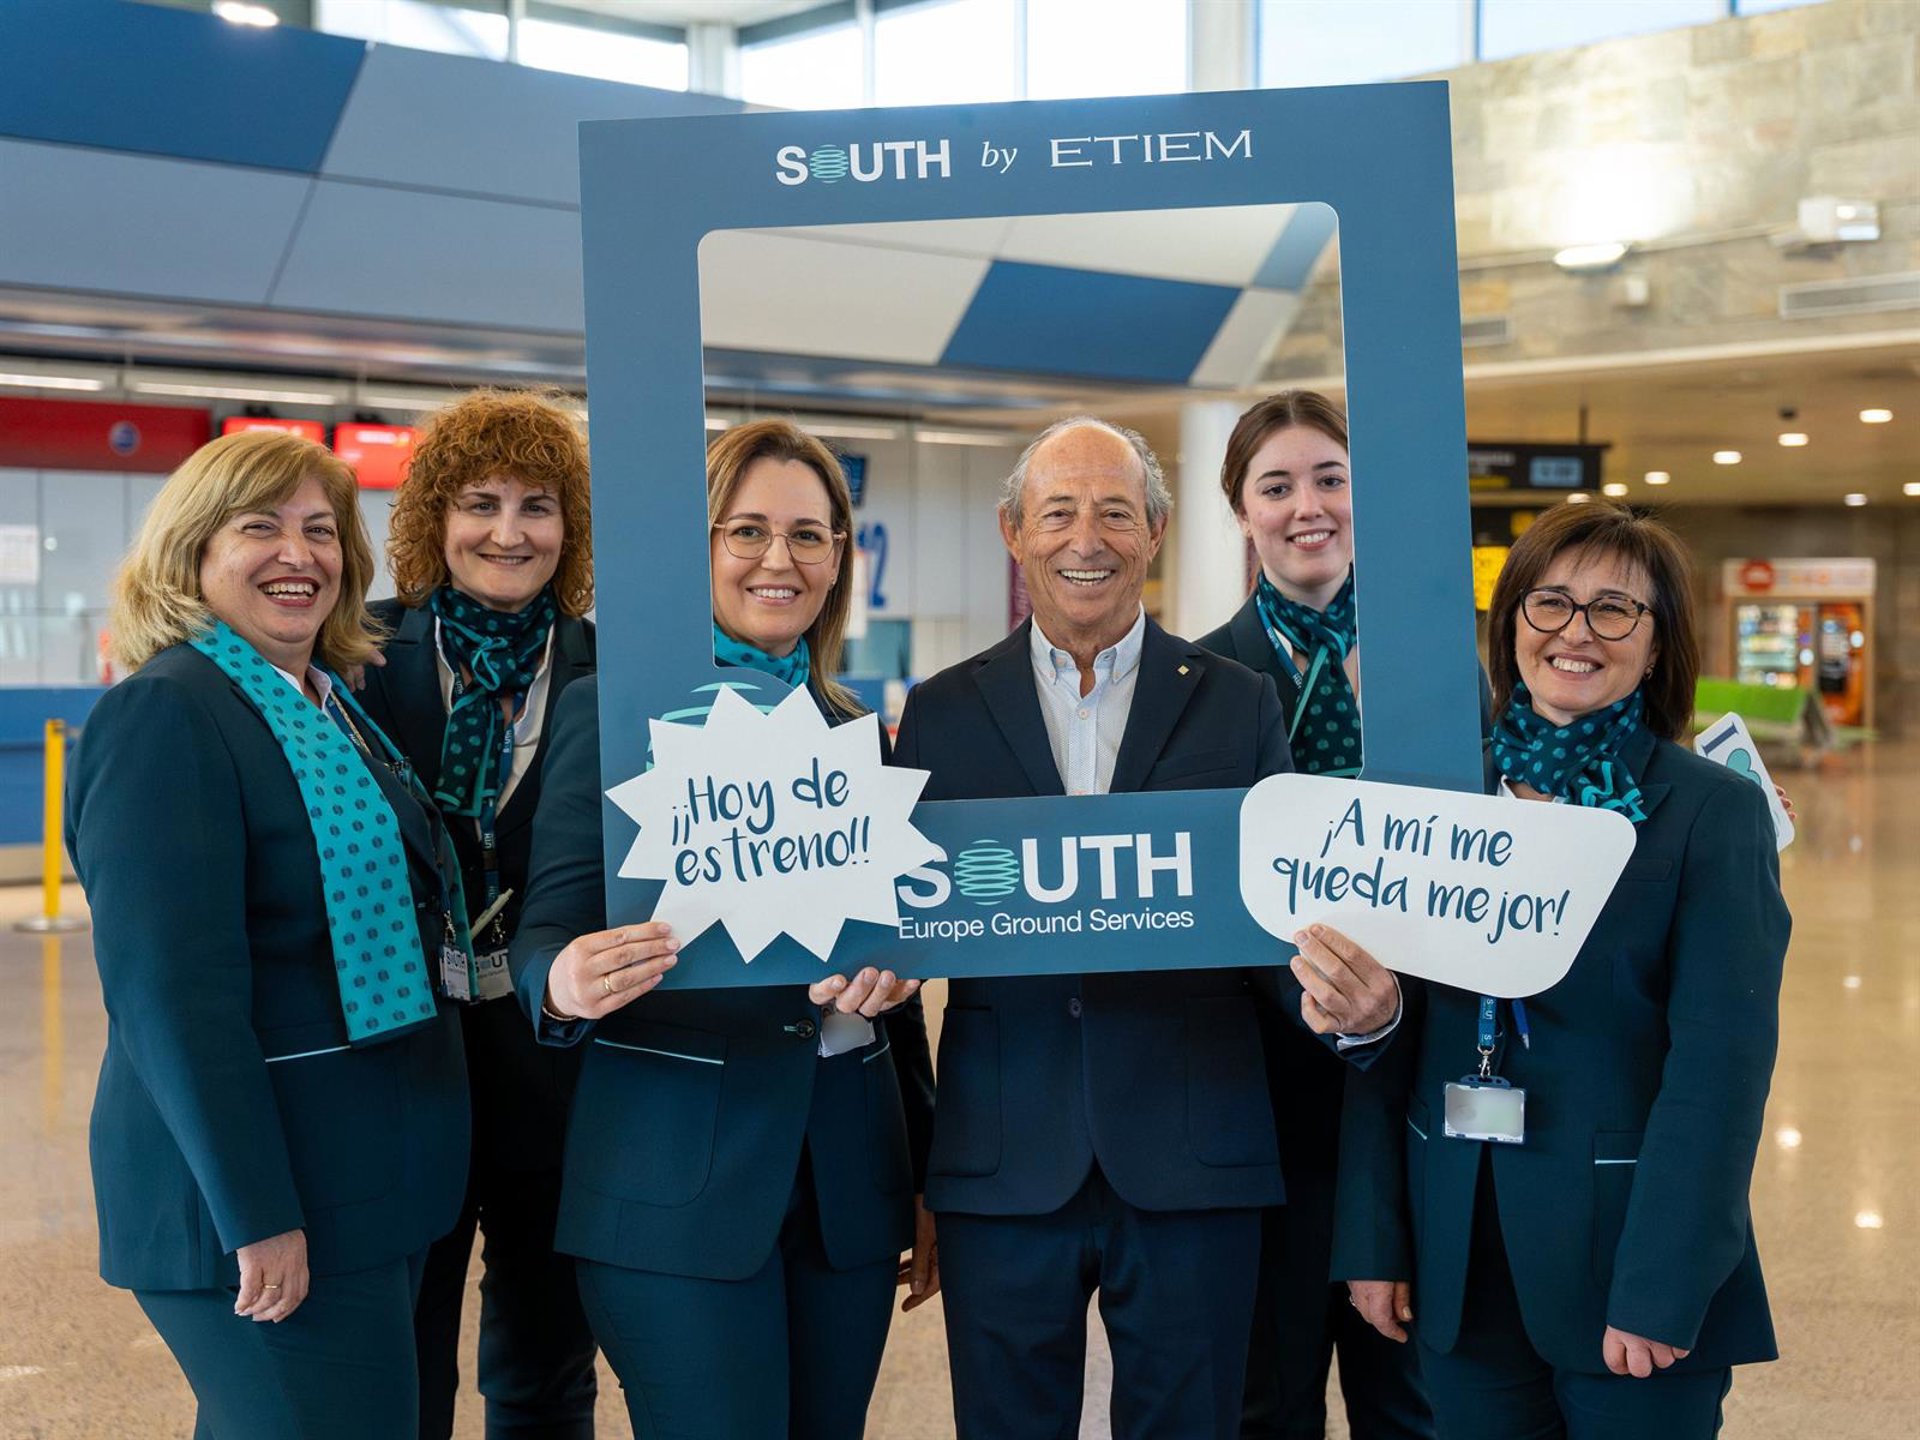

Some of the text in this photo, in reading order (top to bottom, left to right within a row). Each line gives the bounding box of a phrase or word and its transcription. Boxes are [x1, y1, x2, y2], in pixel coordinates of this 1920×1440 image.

[775, 129, 1254, 186] SOUTH by ETIEM
[791, 757, 850, 809] de
[675, 815, 870, 886] estreno!!
[1384, 814, 1440, 857] mí
[1450, 823, 1513, 867] me
[898, 907, 1195, 943] Europe Ground Services
[1272, 856, 1570, 944] queda mejor!
